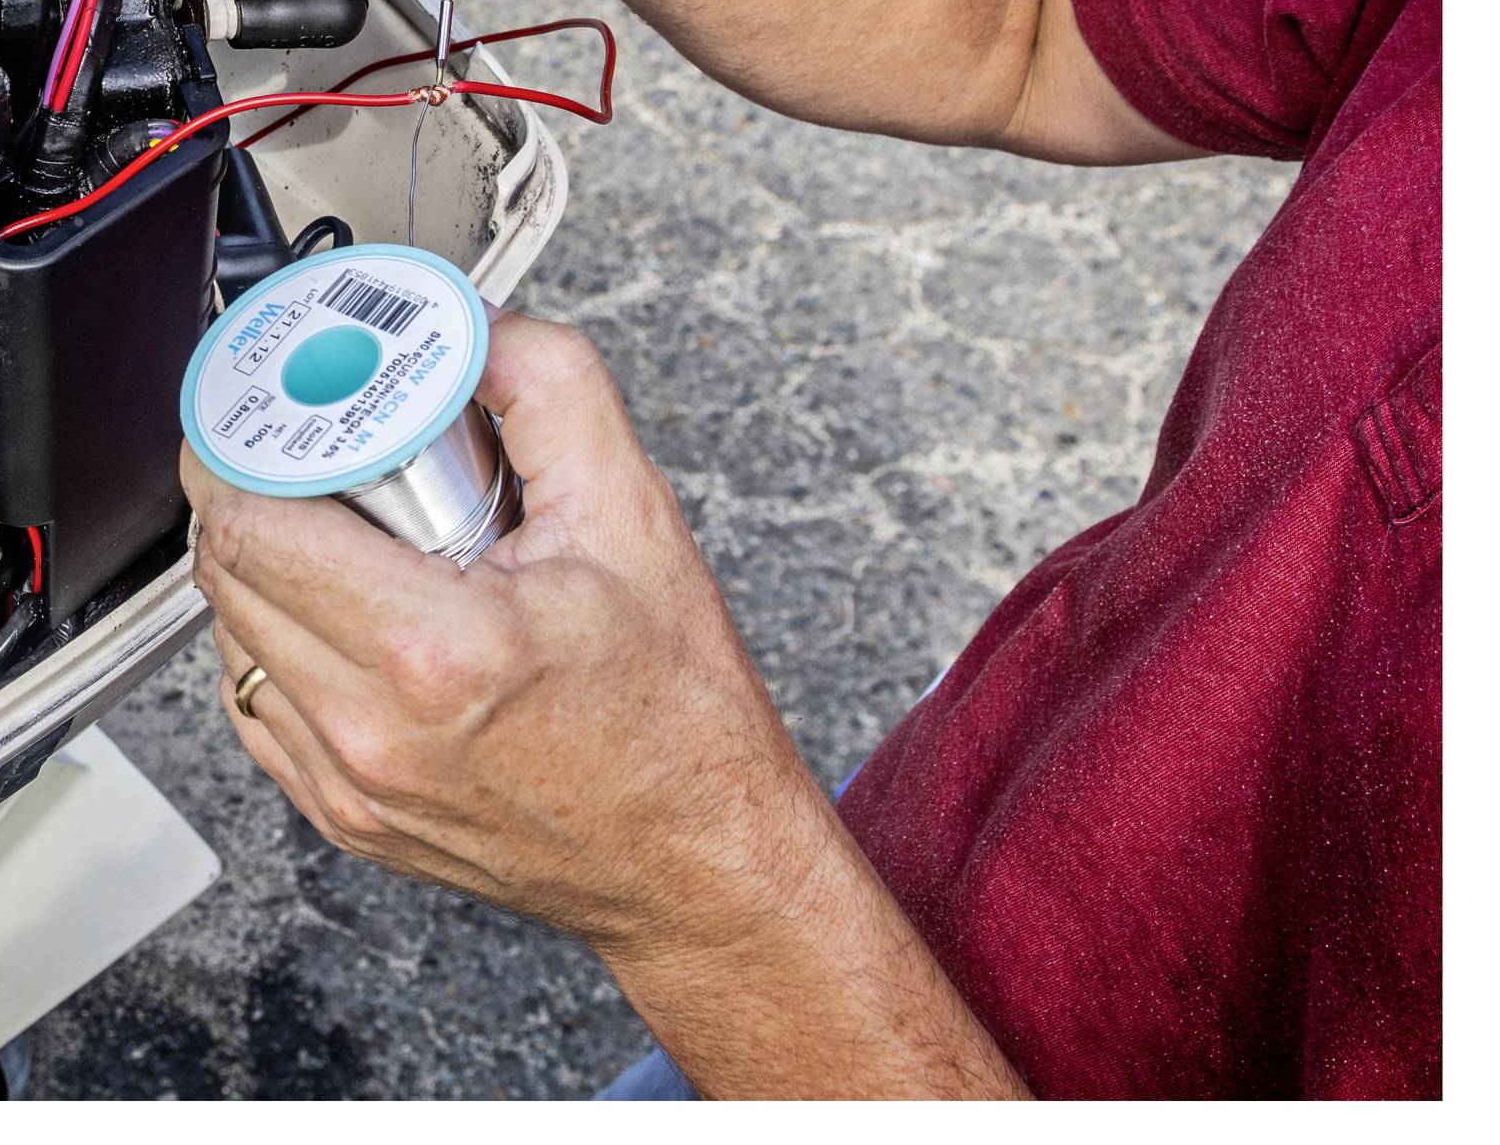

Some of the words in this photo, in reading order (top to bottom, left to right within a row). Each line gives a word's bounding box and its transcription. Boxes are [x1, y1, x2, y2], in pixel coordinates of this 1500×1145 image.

[303, 288, 318, 304] LOT
[409, 345, 451, 386] WSW
[339, 353, 409, 424] T0051401399
[221, 396, 259, 432] 0.8mm
[372, 390, 408, 424] SCN
[244, 424, 273, 448] 100g
[271, 424, 287, 439] NET
[298, 426, 323, 450] RoHS
[347, 429, 373, 452] M1
